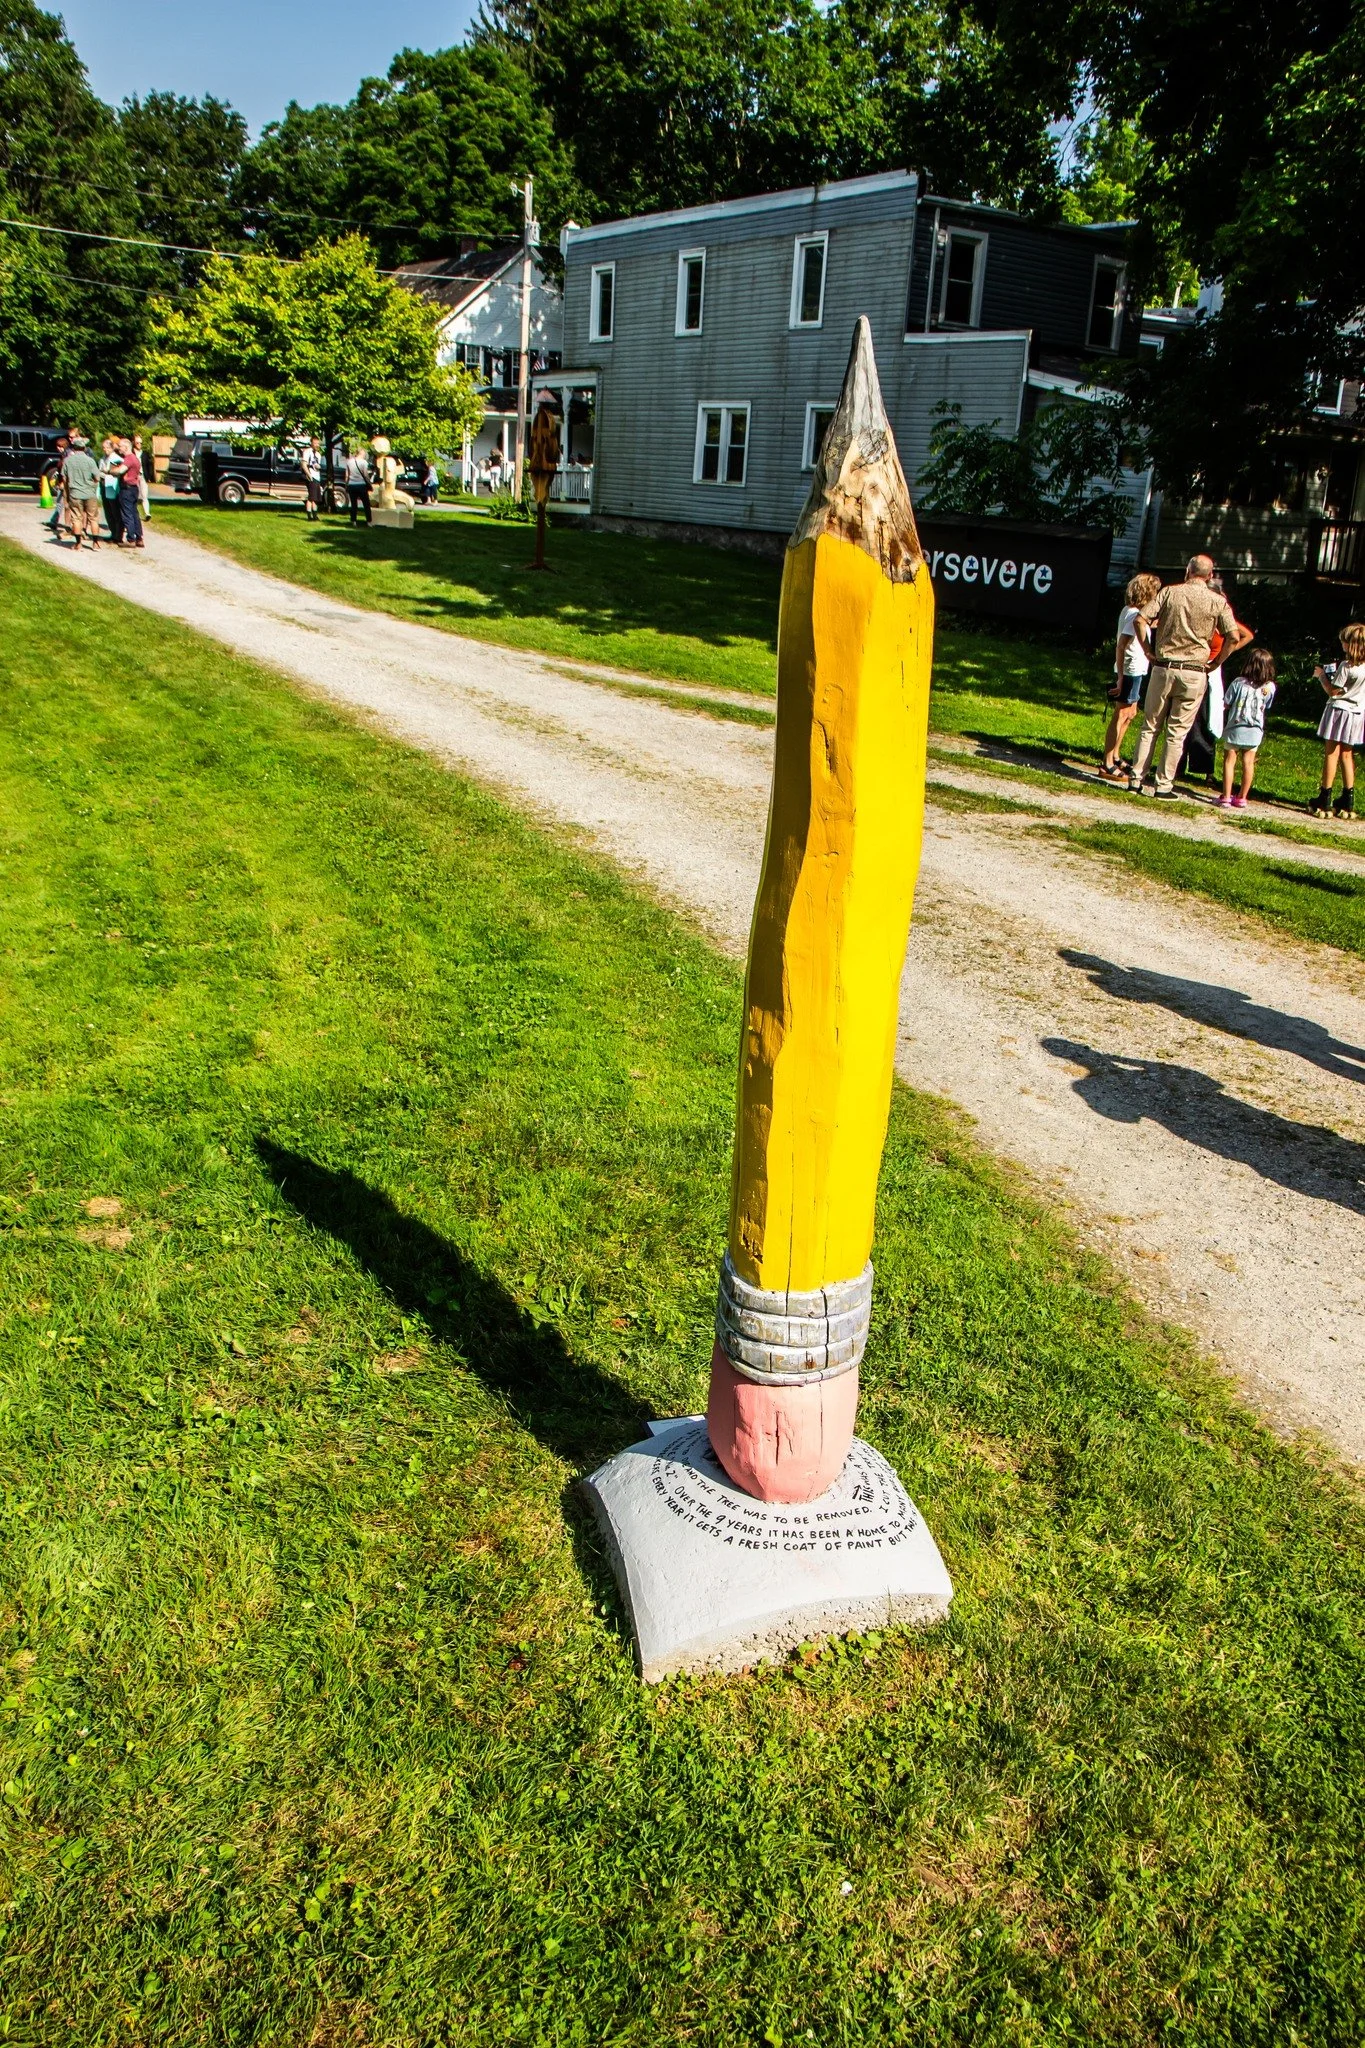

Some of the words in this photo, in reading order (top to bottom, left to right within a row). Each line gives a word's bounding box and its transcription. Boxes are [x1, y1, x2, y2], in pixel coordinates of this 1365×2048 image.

[652, 1476, 669, 1496] EVERY
[664, 1496, 685, 1517] YEAR
[683, 1513, 697, 1523] IT
[696, 1520, 722, 1537] GETS
[723, 1535, 734, 1545] A
[738, 1538, 778, 1550] FRESH
[783, 1542, 817, 1551] COAT
[825, 1541, 842, 1551] OF
[847, 1539, 882, 1550] PAINT
[888, 1530, 907, 1546] BUT
[674, 1486, 696, 1507] OVER
[696, 1503, 713, 1518] THE
[715, 1515, 727, 1525] 9
[727, 1519, 763, 1536] YEARS
[768, 1529, 778, 1538] IT
[782, 1530, 804, 1539] HAS
[810, 1529, 840, 1539] BEEN
[846, 1529, 854, 1538] A
[858, 1525, 888, 1537] HOME
[888, 1520, 901, 1529] TO
[685, 1467, 698, 1480] AND
[697, 1480, 716, 1495] THE
[716, 1494, 741, 1511] TREE
[743, 1508, 767, 1521] WAS
[774, 1516, 788, 1524] TO
[794, 1517, 810, 1525] BE
[816, 1506, 872, 1522] REMOVED.
